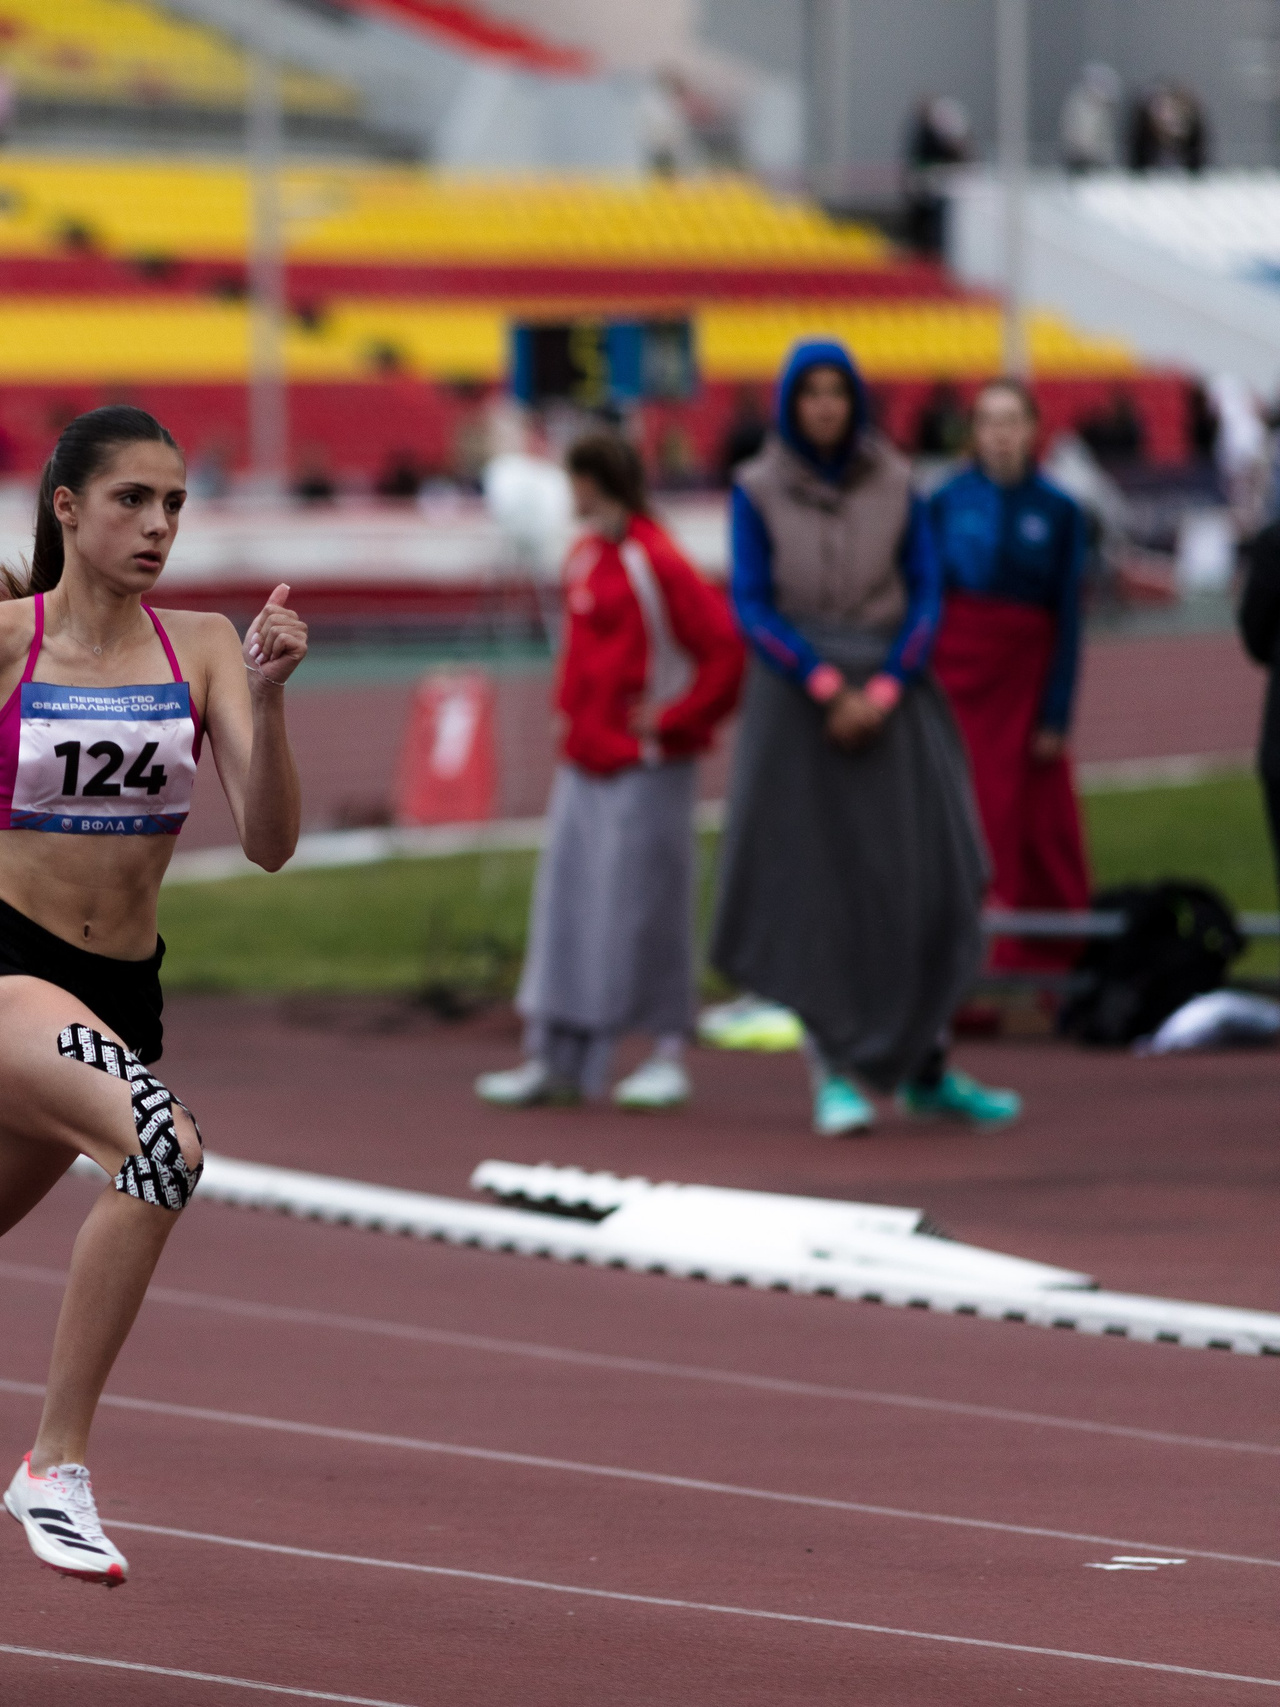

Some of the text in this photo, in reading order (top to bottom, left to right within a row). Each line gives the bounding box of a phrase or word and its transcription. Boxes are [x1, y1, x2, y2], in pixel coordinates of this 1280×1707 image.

[68, 694, 155, 706] ПЕРВЕНСТВО
[54, 740, 167, 797] 124
[81, 819, 126, 832] ВФЛА
[79, 1027, 95, 1063] ROCKTAPE
[138, 1108, 172, 1145] ROCKTAPE
